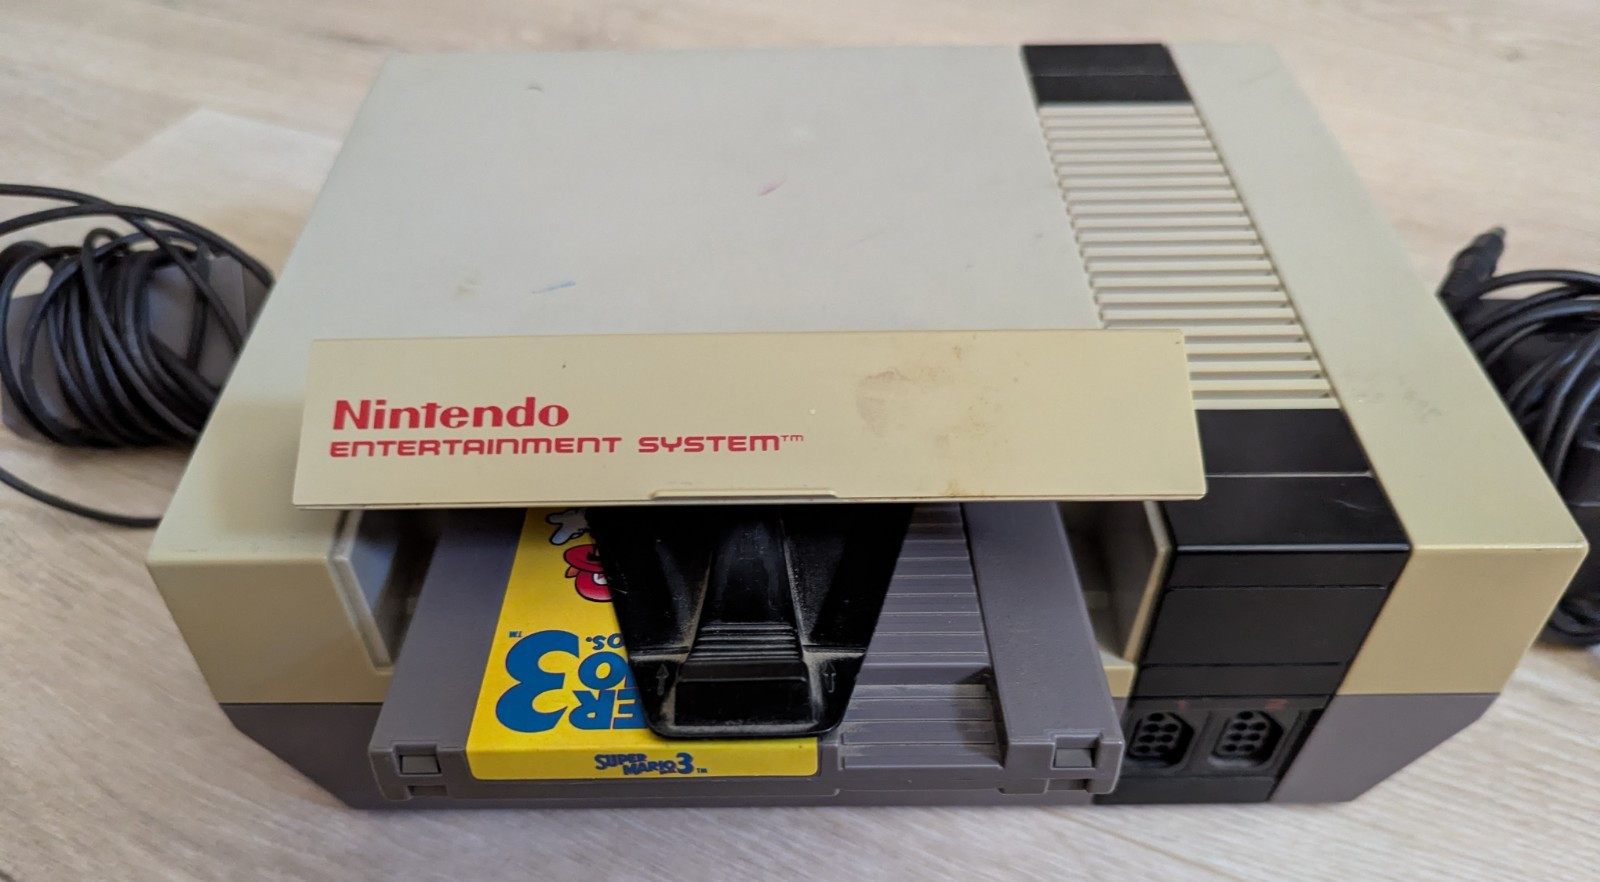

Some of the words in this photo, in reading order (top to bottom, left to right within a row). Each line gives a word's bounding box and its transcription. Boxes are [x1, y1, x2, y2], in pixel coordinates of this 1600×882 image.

[333, 397, 569, 430] Nintendo
[330, 437, 622, 458] ENTERTAINMENT
[495, 629, 580, 733] 3
[594, 753, 647, 770] SUPER
[676, 752, 694, 774] 3
